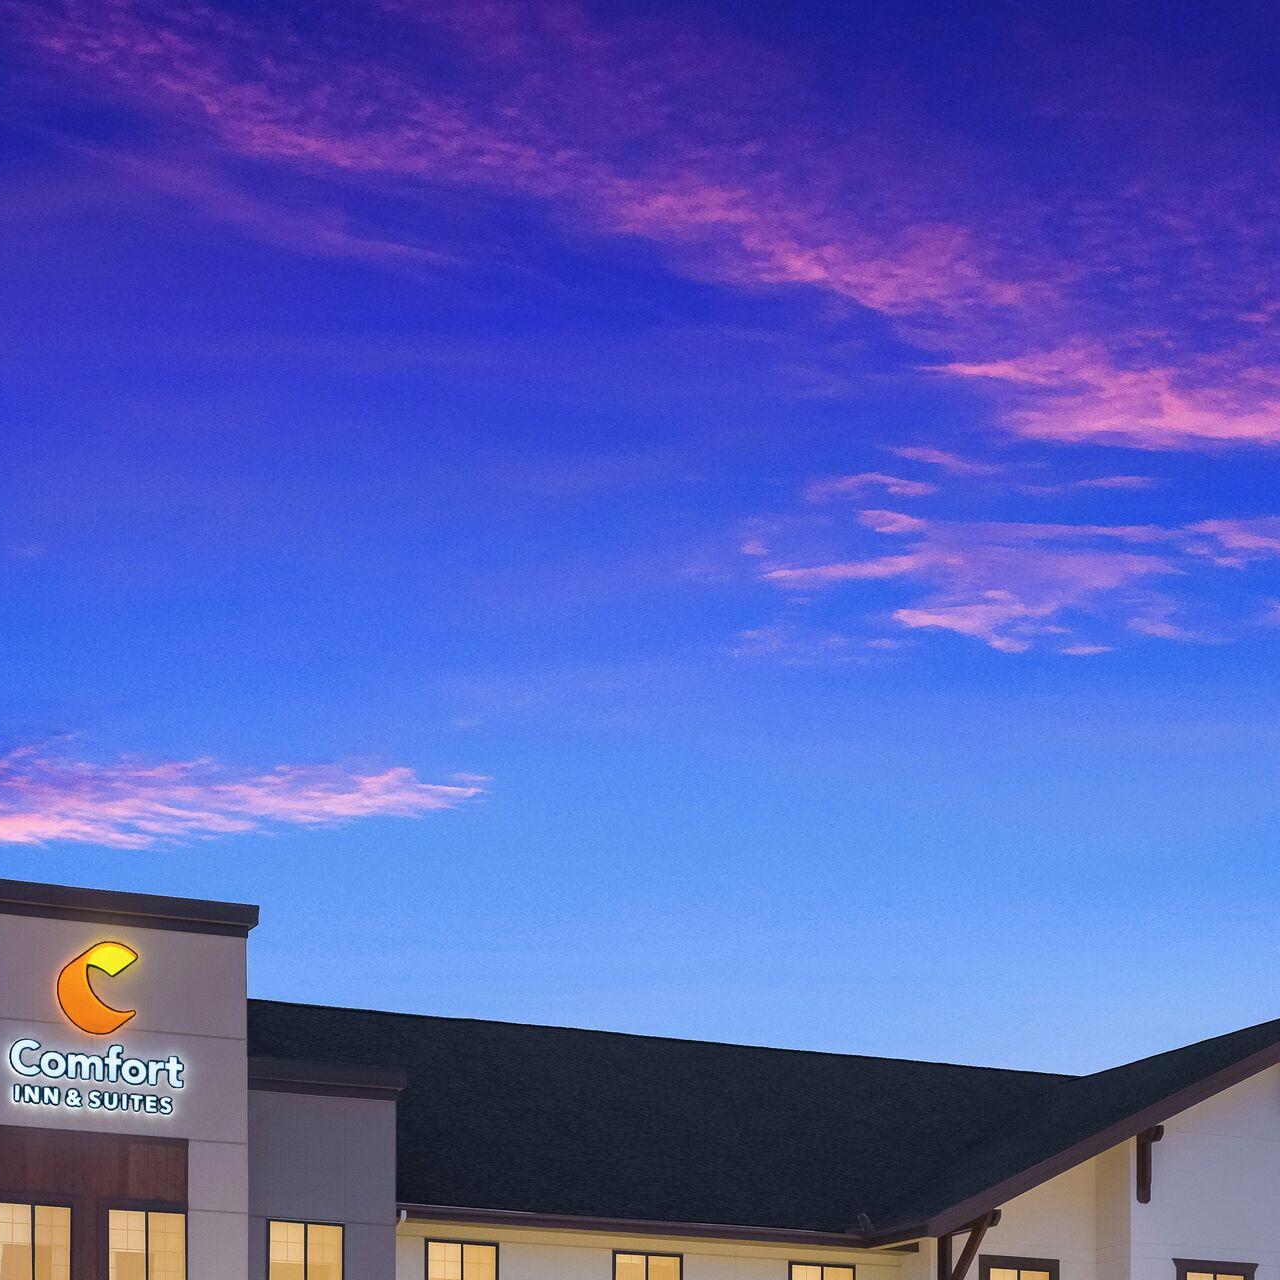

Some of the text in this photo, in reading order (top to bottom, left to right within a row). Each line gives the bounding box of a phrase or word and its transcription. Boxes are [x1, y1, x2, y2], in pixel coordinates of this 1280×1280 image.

[9, 1038, 184, 1088] Comfort
[13, 1084, 173, 1115] INN & SUITES
